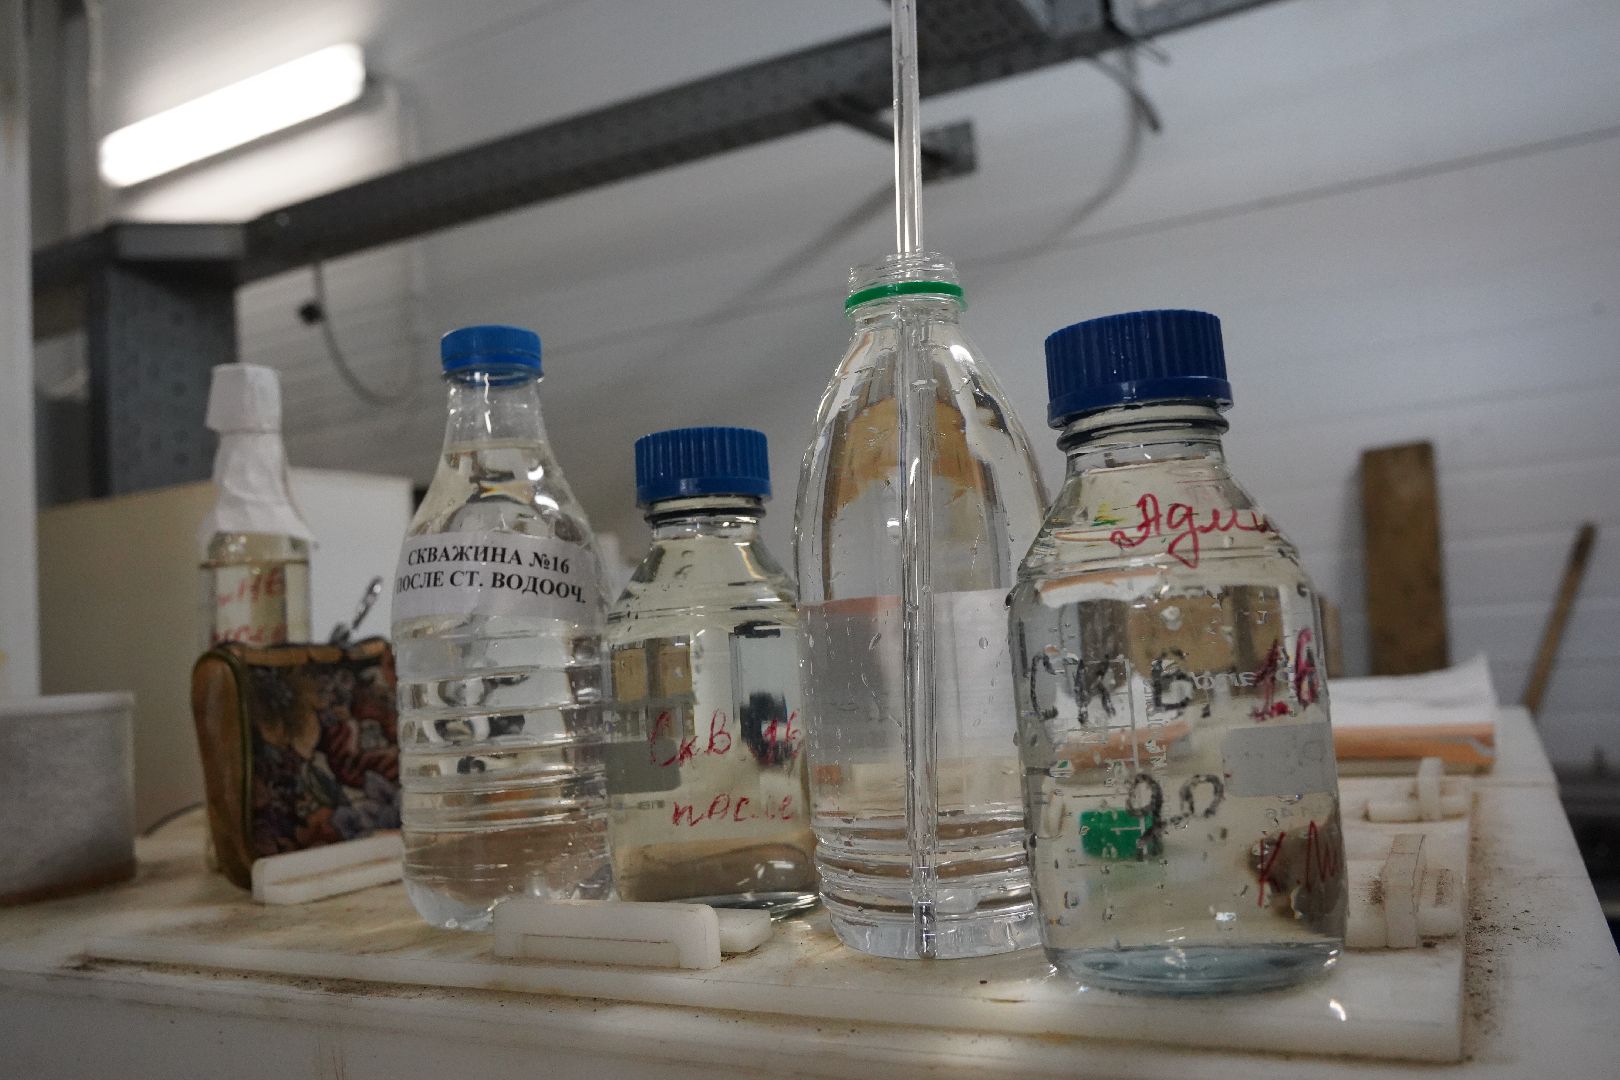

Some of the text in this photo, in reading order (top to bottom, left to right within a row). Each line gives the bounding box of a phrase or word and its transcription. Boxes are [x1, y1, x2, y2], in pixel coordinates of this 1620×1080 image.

[407, 545, 570, 574] СКВАЖИНА №16
[449, 570, 484, 587] СТ.
[491, 571, 586, 603] ВОДООЧ.
